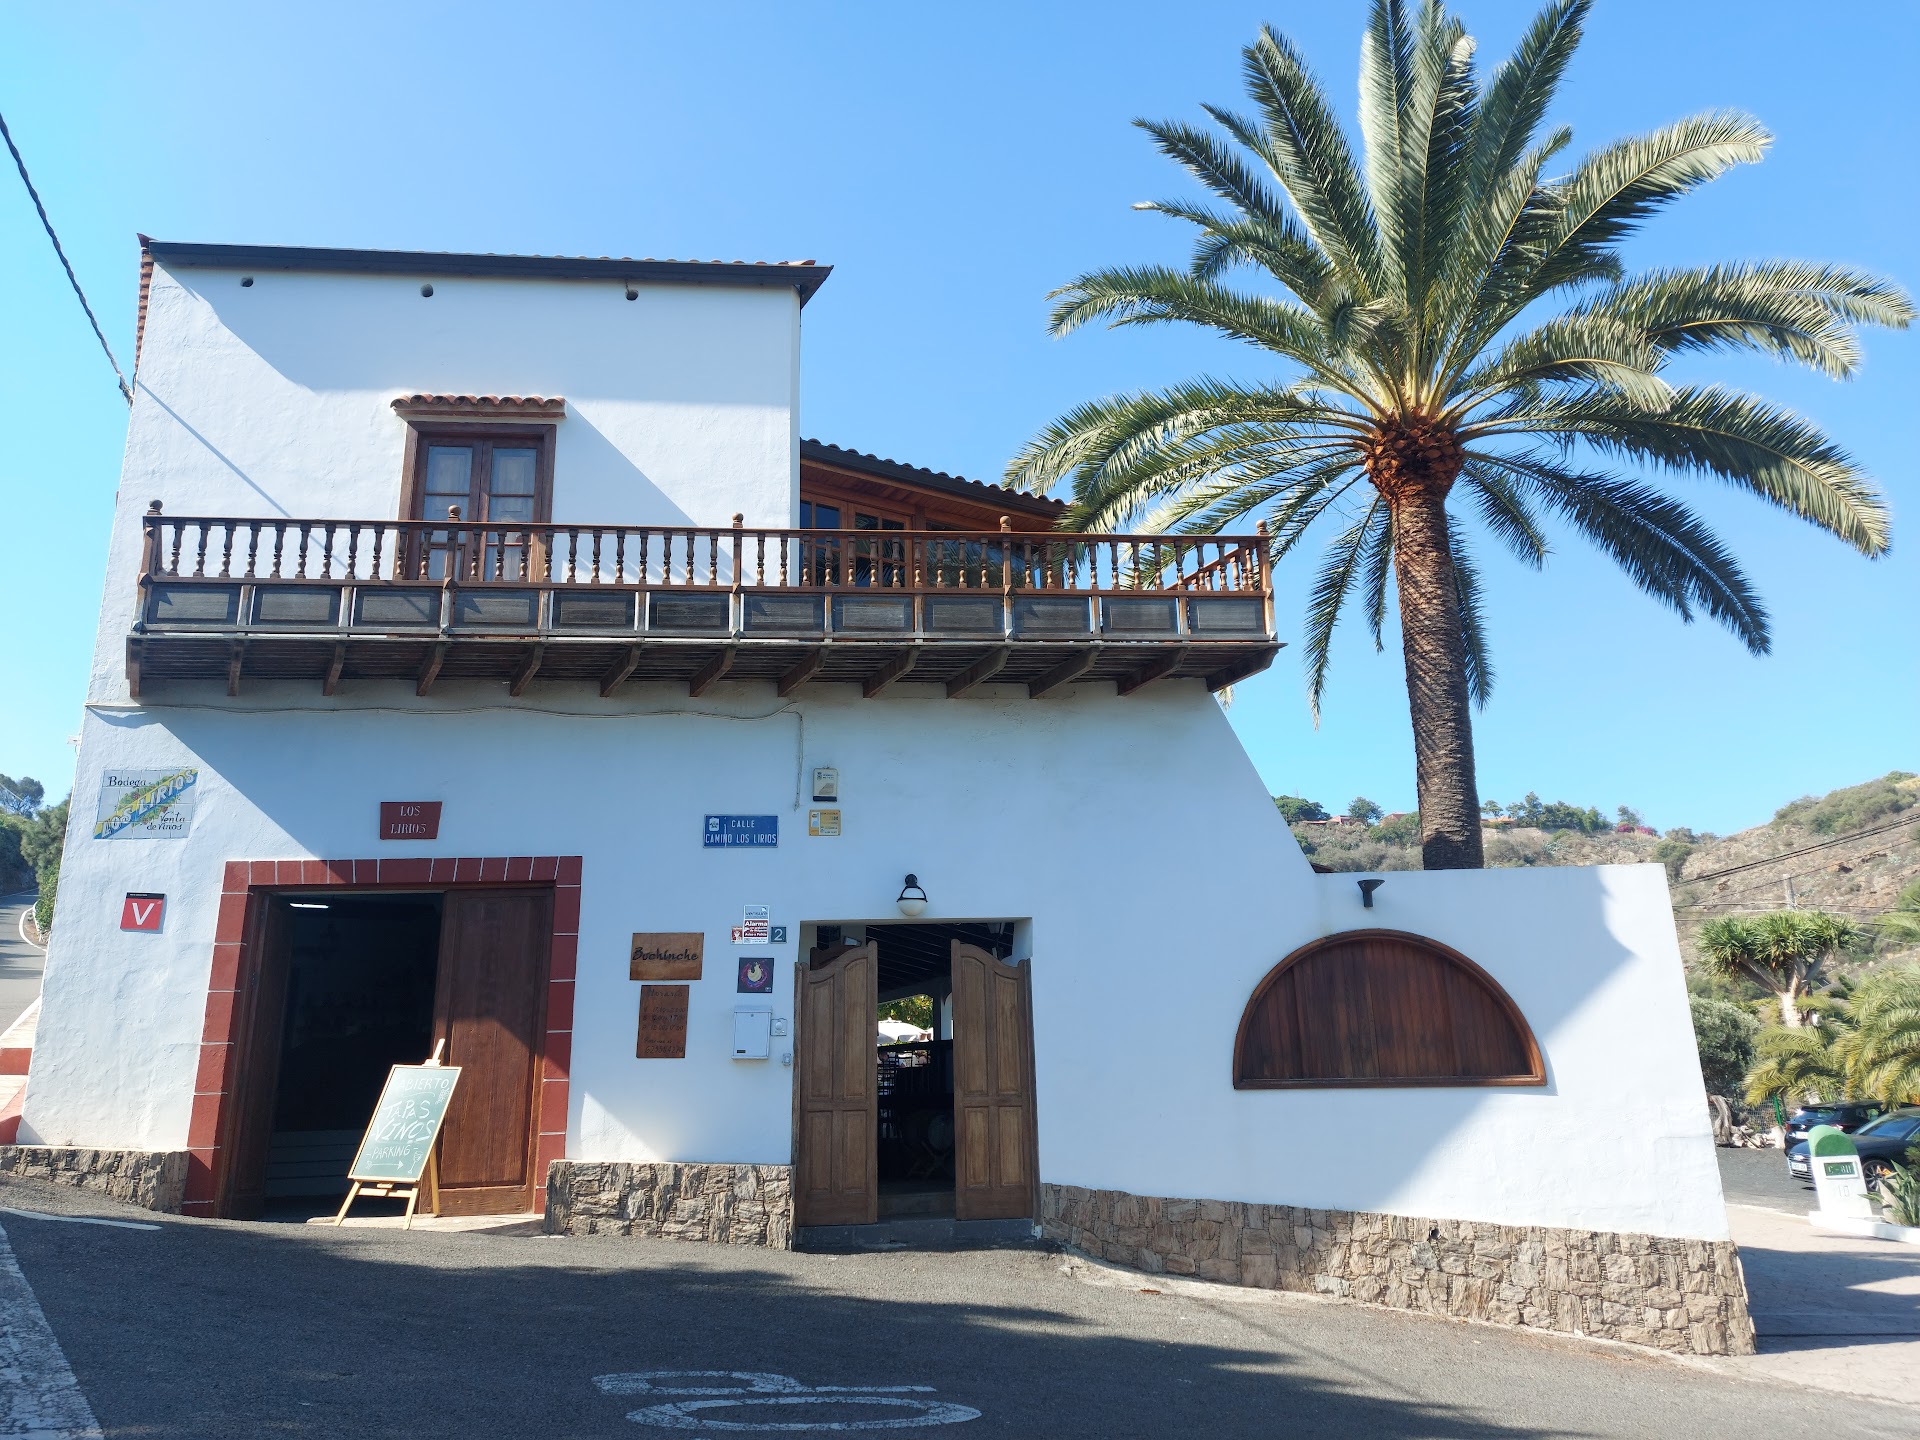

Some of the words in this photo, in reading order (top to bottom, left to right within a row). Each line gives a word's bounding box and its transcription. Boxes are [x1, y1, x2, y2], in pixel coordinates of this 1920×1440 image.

[108, 776, 147, 788] Bodega
[101, 807, 134, 839] LOS
[138, 769, 194, 815] LIRIOS
[160, 811, 186, 822] Venta
[400, 805, 421, 817] LOS
[146, 822, 157, 831] de
[390, 823, 427, 834] LIRIOS
[731, 819, 755, 828] CALLE
[705, 834, 732, 844] CAMINO
[736, 834, 750, 844] LOS
[753, 833, 777, 844] LIRIOS
[132, 902, 155, 926] V
[774, 928, 783, 941] 2
[399, 1077, 449, 1092] ABIERTO
[382, 1099, 431, 1119] TAPAS
[374, 1119, 435, 1141] VINOS
[371, 1144, 411, 1159] PARKING
